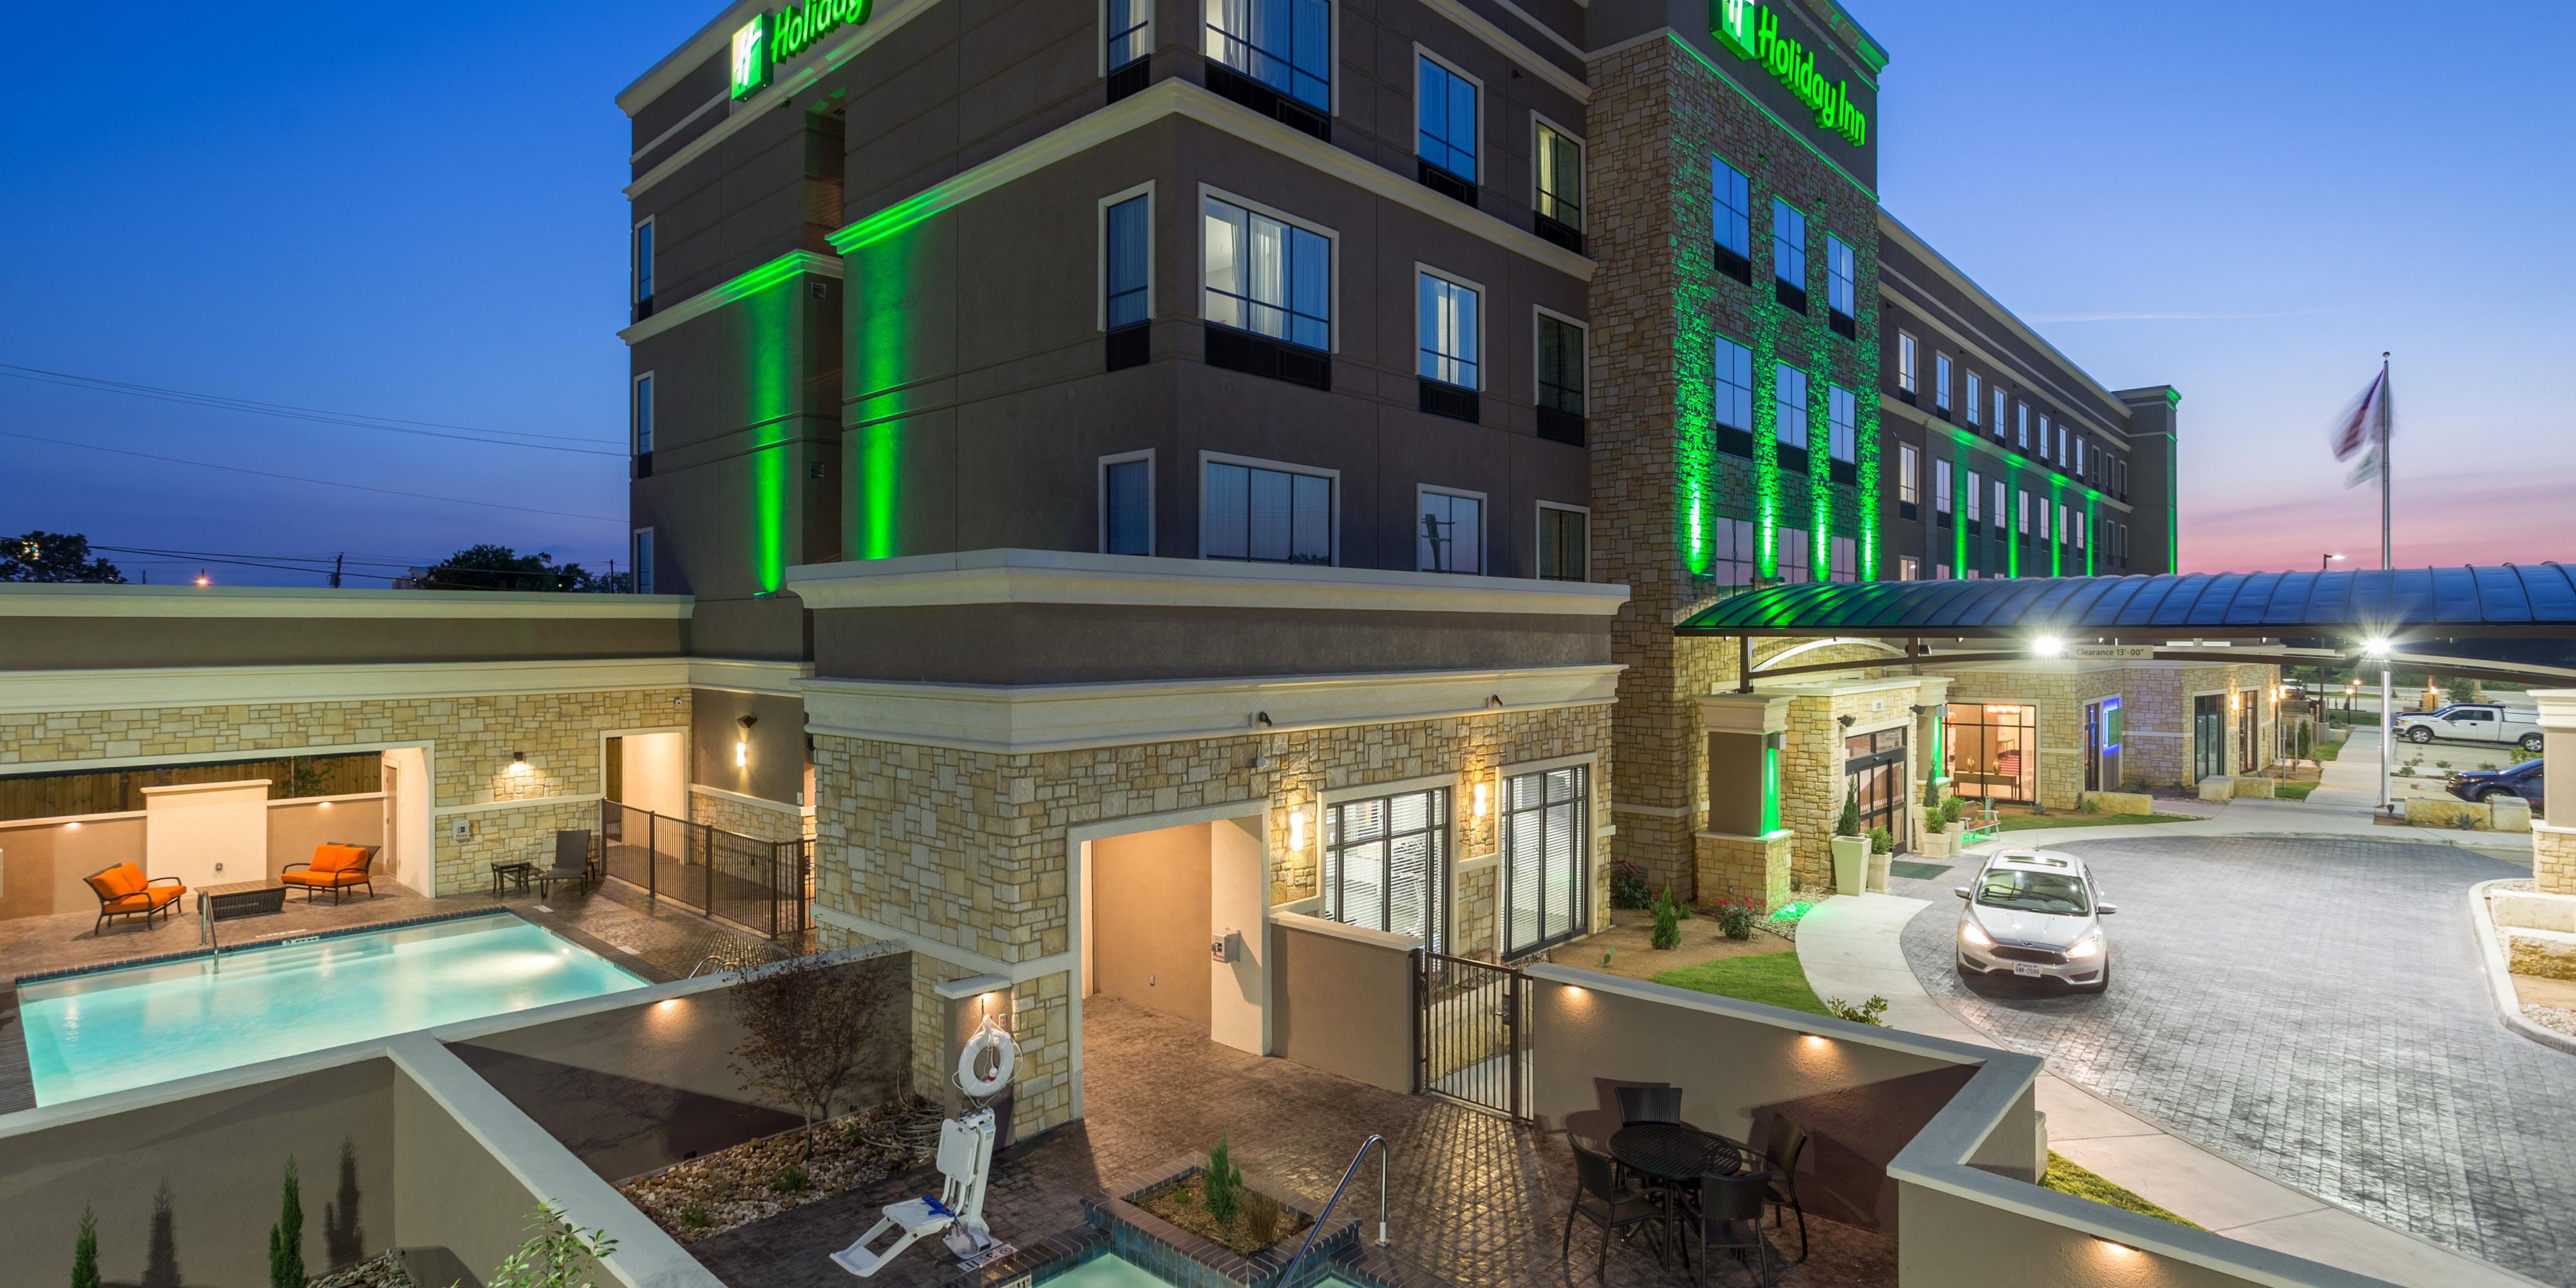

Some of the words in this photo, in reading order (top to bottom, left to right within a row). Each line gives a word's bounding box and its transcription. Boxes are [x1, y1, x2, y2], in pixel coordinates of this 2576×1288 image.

[771, 0, 863, 62] Holiday
[1758, 5, 1837, 128] Holiday
[1839, 80, 1866, 146] Inn
[2076, 648, 2114, 656] Clearance
